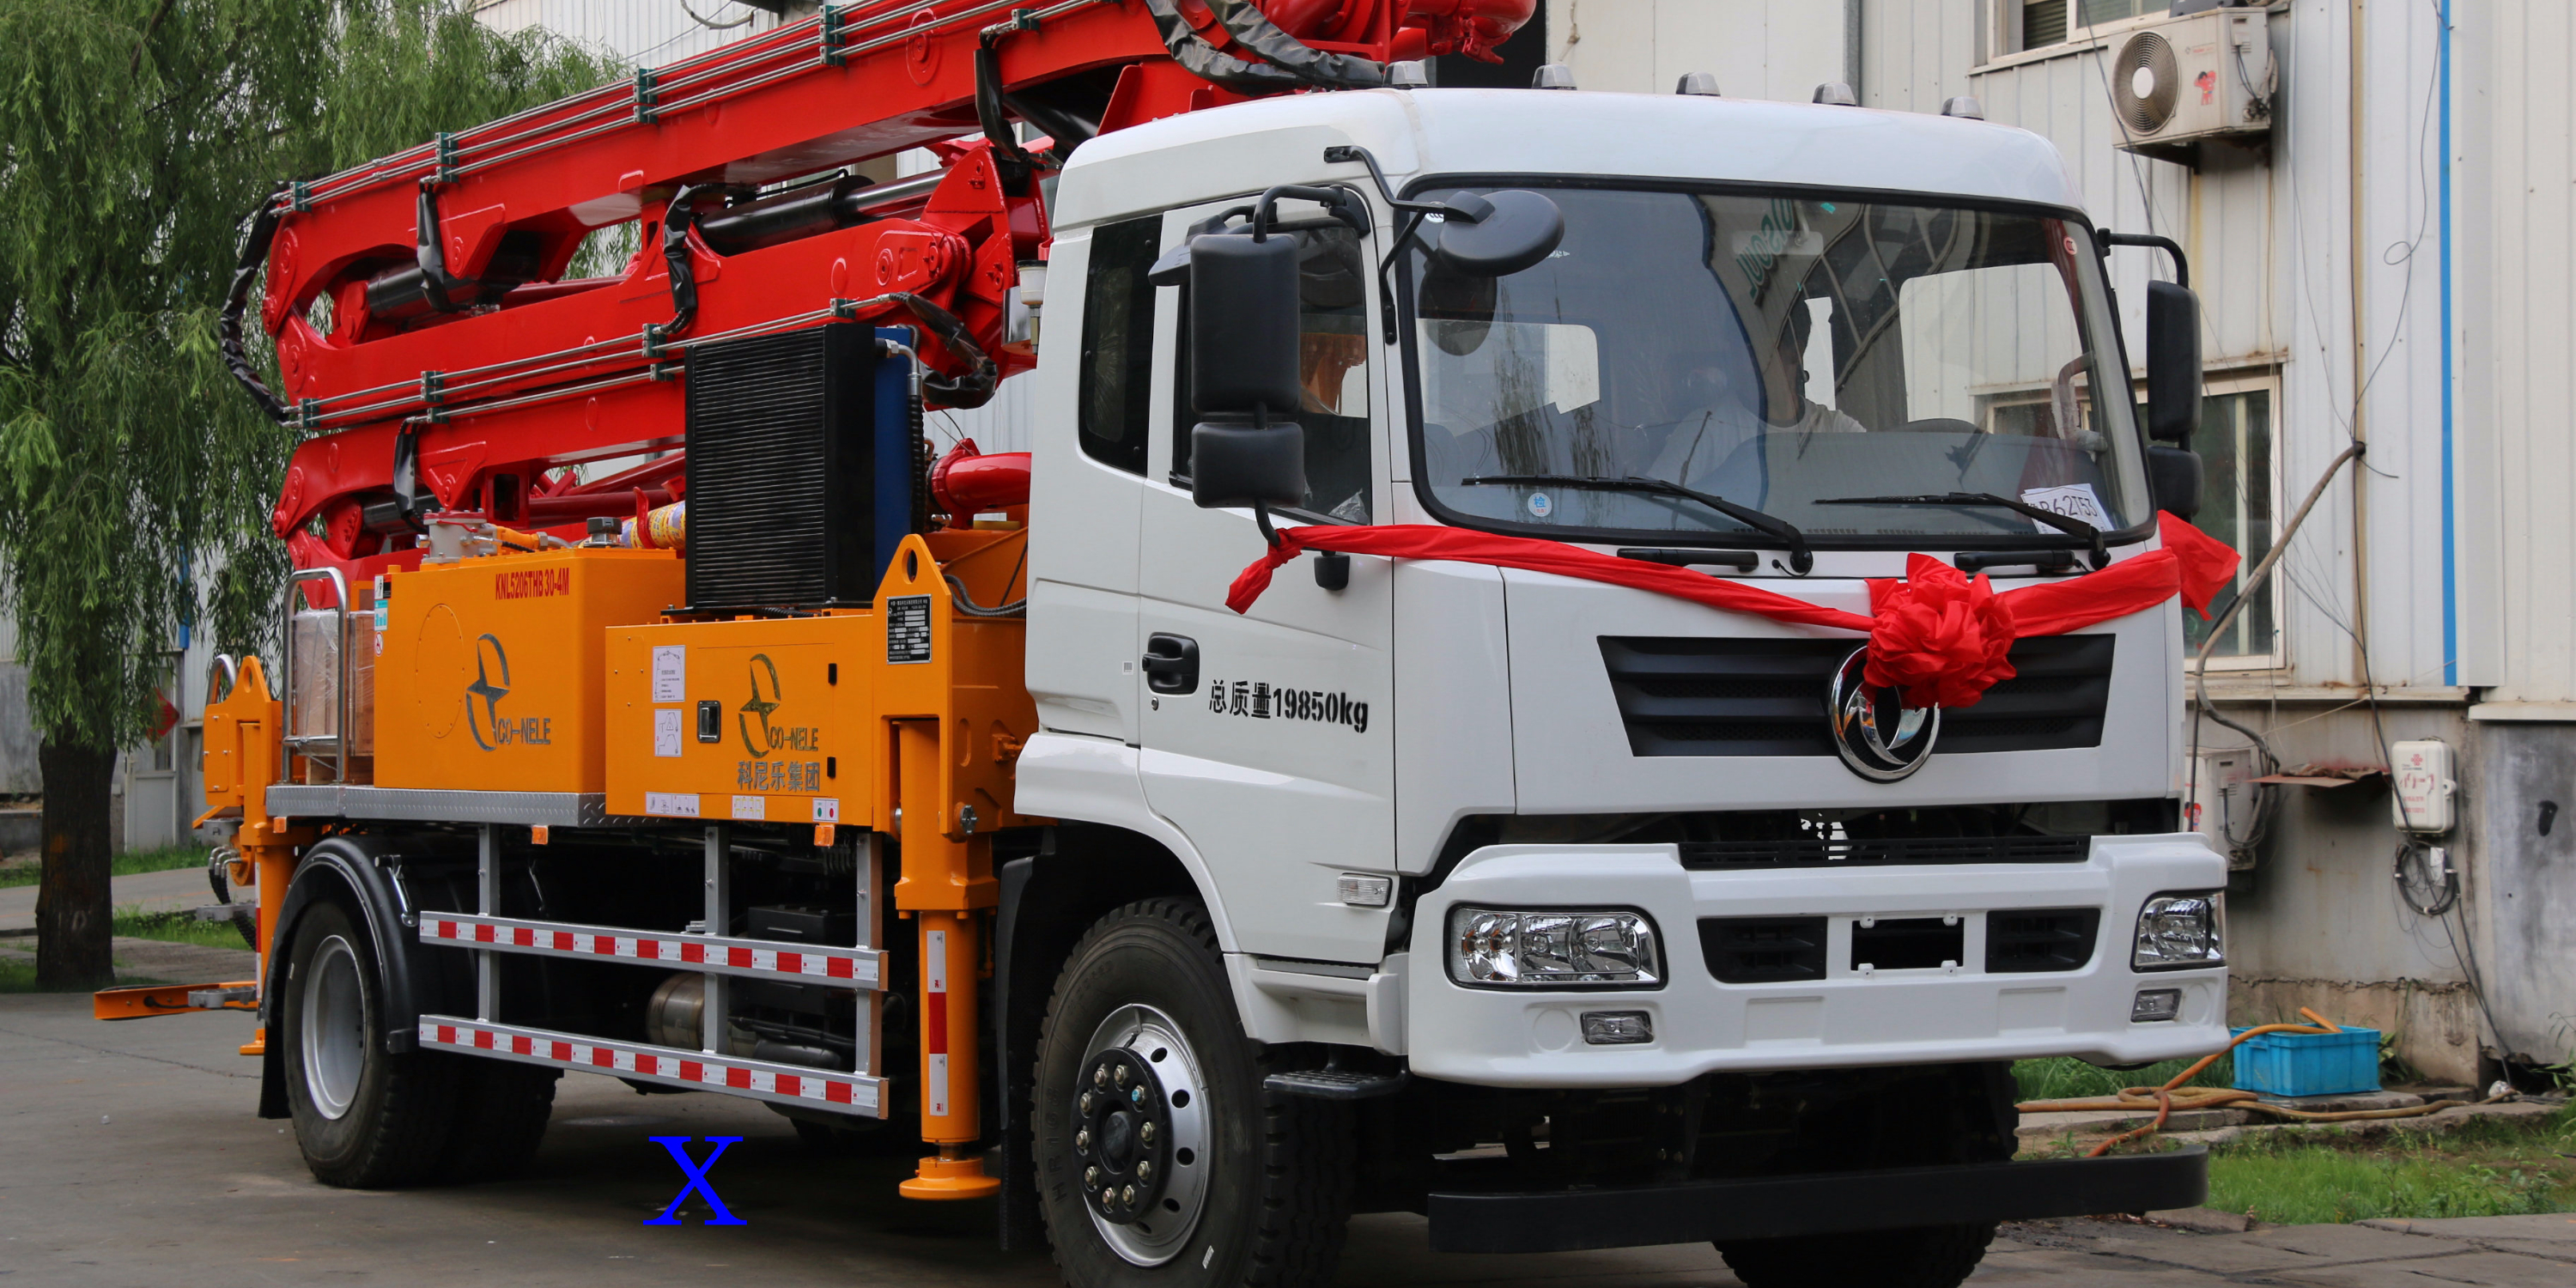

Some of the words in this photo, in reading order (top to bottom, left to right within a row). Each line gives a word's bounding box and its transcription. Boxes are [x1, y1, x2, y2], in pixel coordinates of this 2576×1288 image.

[495, 570, 543, 600] KNL5206THB
[544, 568, 569, 597] 30-4M
[497, 718, 550, 744] CO-NELE
[769, 726, 818, 751] CO-NELE
[737, 761, 819, 792] 科尼乐集团
